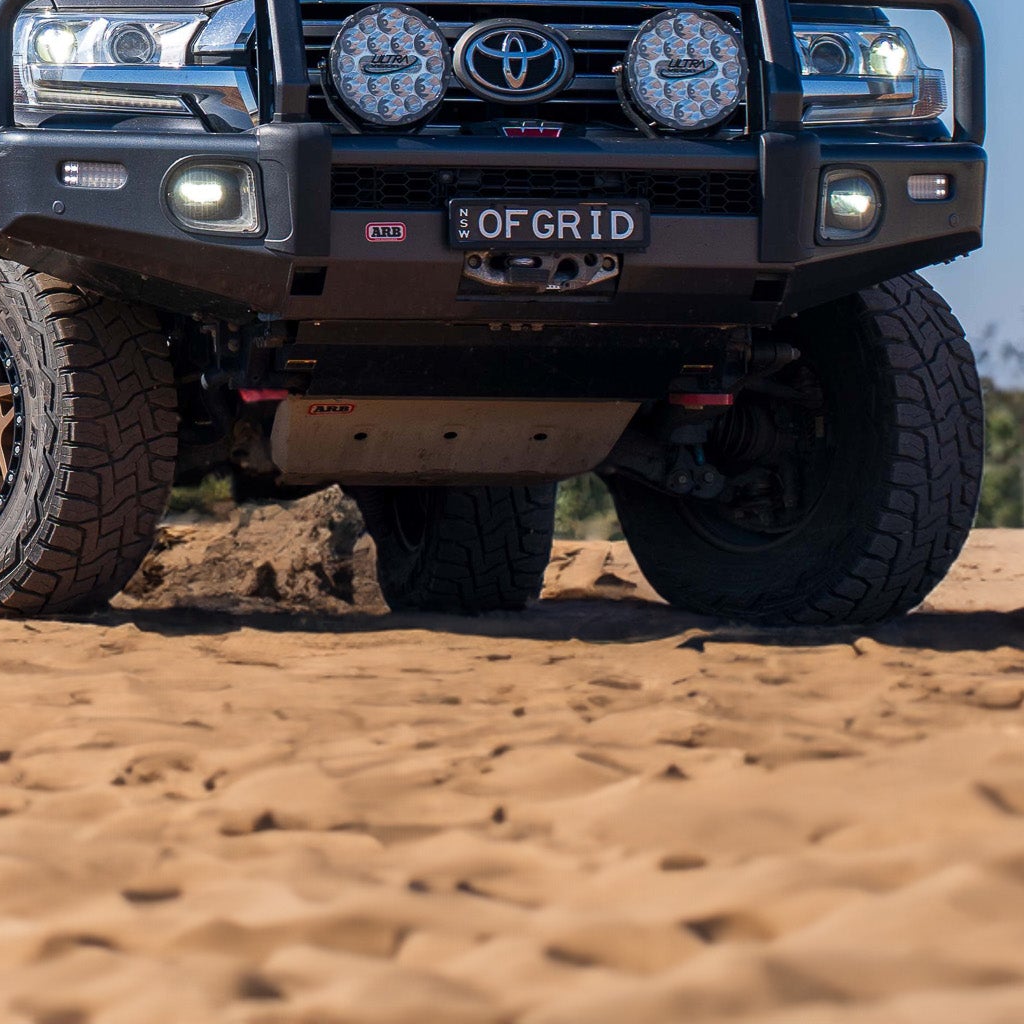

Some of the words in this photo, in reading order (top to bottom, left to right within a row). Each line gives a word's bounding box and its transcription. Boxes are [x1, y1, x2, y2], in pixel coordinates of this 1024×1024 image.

[371, 54, 409, 64] ULTRA
[668, 58, 706, 68] ULTRA
[478, 209, 635, 240] OFGRID
[371, 226, 402, 237] ARB
[313, 405, 350, 413] ARB
